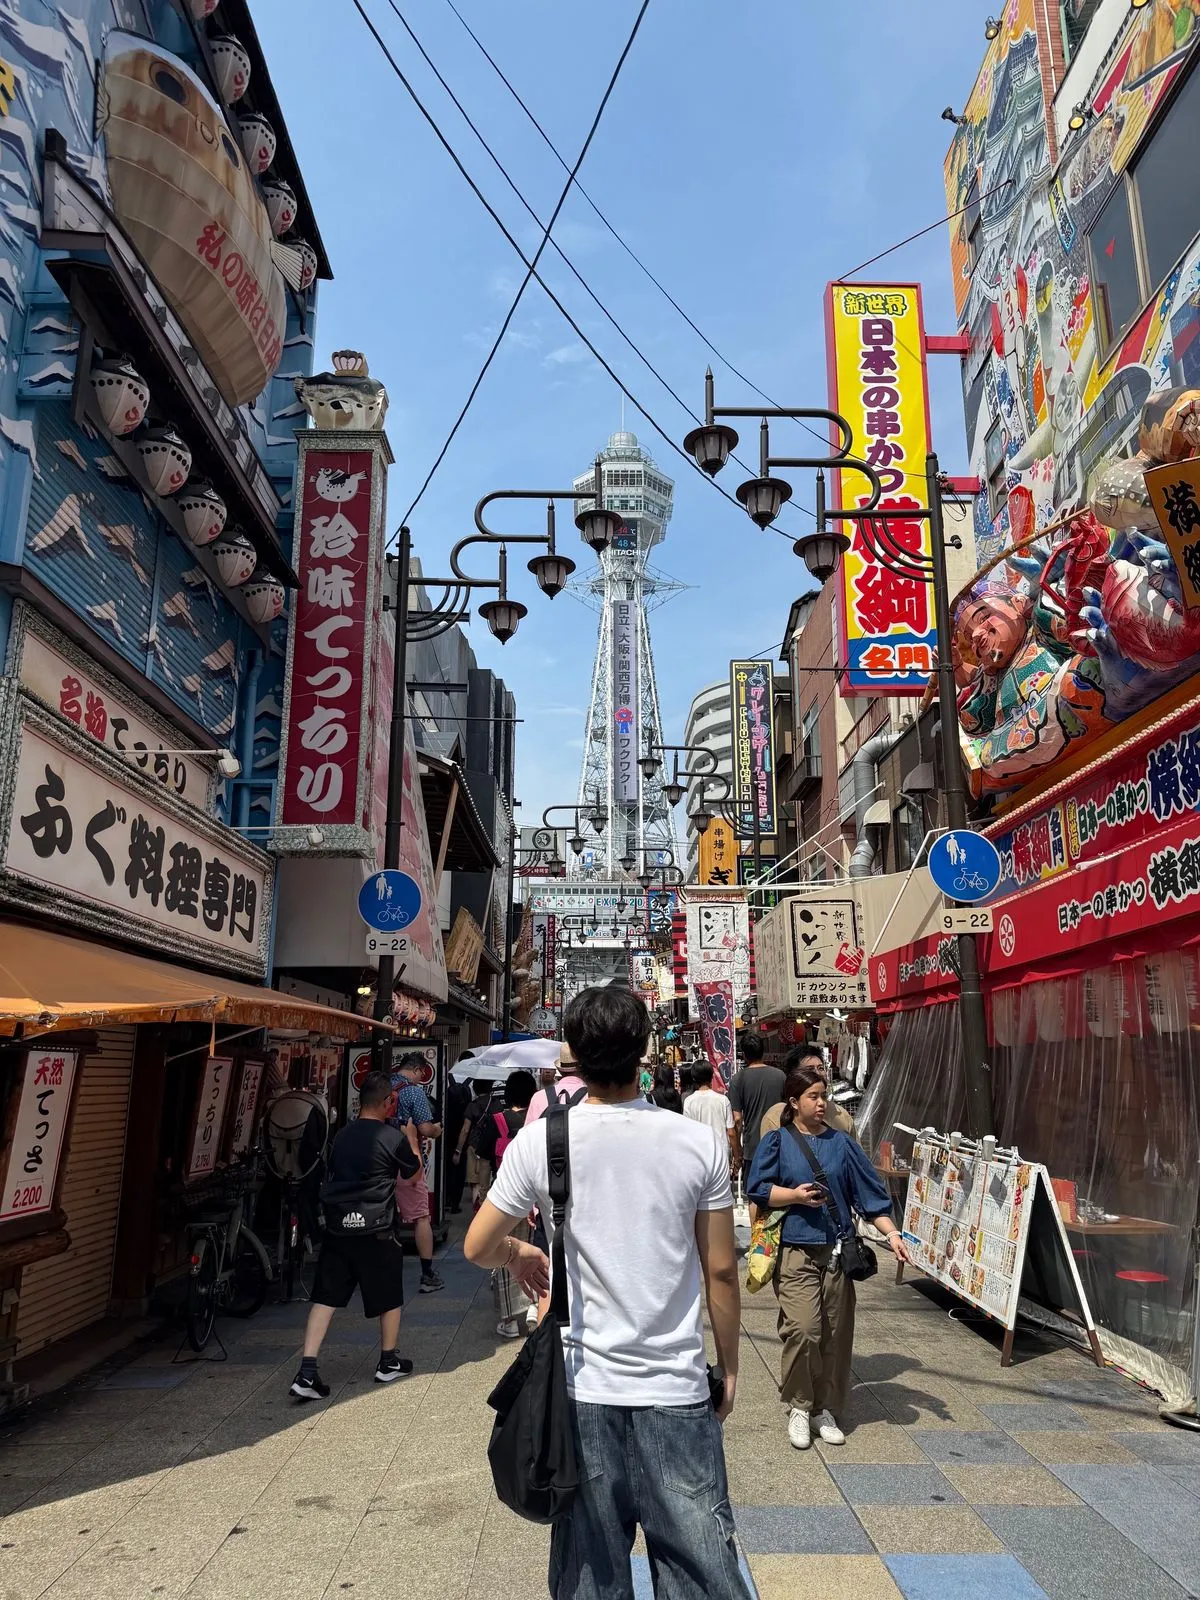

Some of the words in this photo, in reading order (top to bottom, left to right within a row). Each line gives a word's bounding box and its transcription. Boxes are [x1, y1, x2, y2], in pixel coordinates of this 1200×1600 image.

[844, 293, 907, 315] 新世界
[860, 319, 904, 493] 日本一の串かつ
[852, 497, 929, 634] 横綱
[618, 604, 631, 705] 日立、大阪・関西万博
[862, 645, 930, 676] 名門
[1079, 781, 1148, 842] 日本一の串かつ
[713, 827, 726, 861] 串揚げ
[943, 913, 990, 929] 9-22
[1058, 880, 1146, 931] 日本一の串かつ
[368, 939, 407, 951] 9-22
[797, 983, 806, 991] 1F
[809, 982, 867, 992] カウンター席
[797, 994, 807, 1003] 2F
[809, 993, 868, 1004] 座敷あります
[34, 1056, 66, 1086] 天然
[202, 1065, 223, 1145] てっちり
[12, 1184, 43, 1209] 2,200
